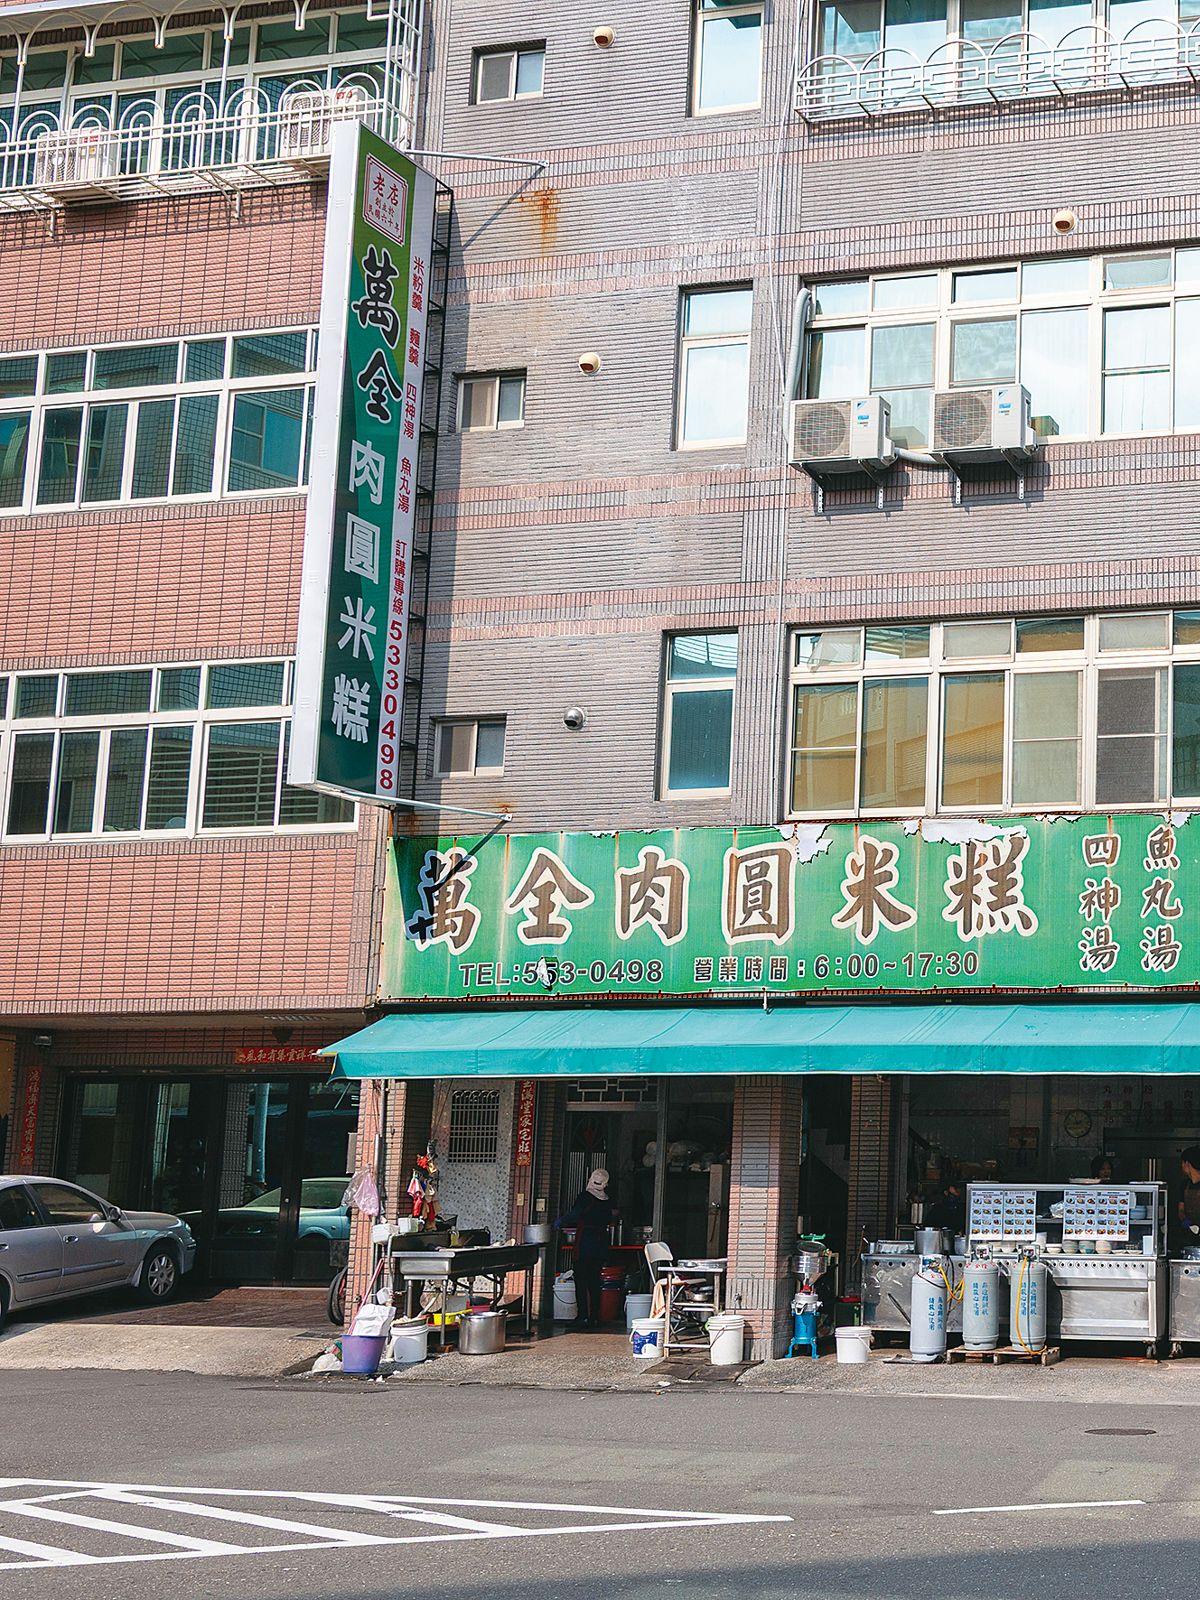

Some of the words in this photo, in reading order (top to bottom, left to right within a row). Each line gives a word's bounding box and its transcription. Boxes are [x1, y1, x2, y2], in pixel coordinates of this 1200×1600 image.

[368, 204, 400, 232] 民國六十年
[372, 172, 399, 206] 老店
[411, 256, 425, 313] 米粉羹
[409, 328, 420, 367] 麵羹
[404, 382, 416, 440] 四神湯
[331, 244, 402, 744] 萬全肉圓米糕
[397, 457, 411, 514] 魚丸湯
[392, 540, 407, 615] 訂購專線
[379, 619, 403, 790] 5330498
[405, 836, 1040, 953] 萬全肉圓米糕
[1079, 832, 1123, 973] 四神湯
[1139, 824, 1183, 973] 魚丸湯
